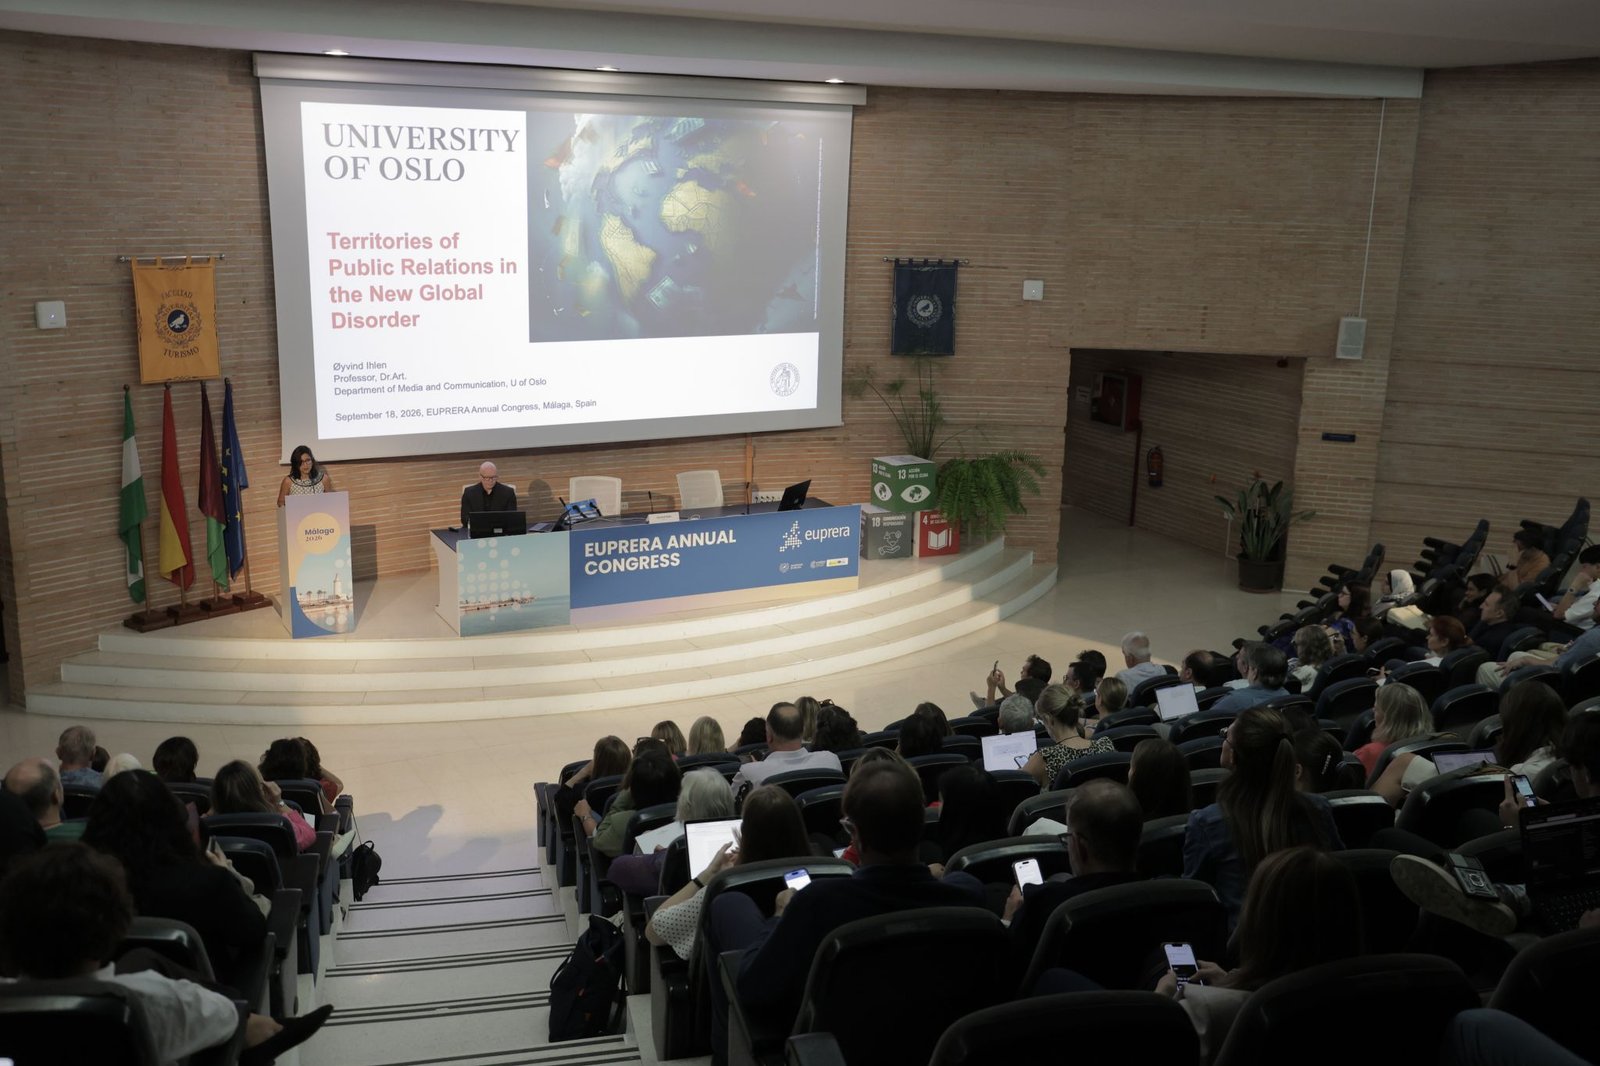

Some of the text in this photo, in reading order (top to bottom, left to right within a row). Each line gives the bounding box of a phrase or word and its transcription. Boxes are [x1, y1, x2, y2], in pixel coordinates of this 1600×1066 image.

[322, 123, 520, 152] UNIVERSITY
[324, 155, 465, 182] OF OSLO
[326, 232, 460, 250] Territories of
[329, 258, 517, 276] Public Relations in
[329, 284, 483, 303] the New Global
[331, 311, 420, 329] Disorder
[163, 345, 200, 359] TURISMO
[333, 361, 387, 372] Øyvind Ihlen
[333, 373, 377, 383] Professor,
[334, 378, 547, 396] Department of Media and Communication, U of Oslo
[335, 399, 597, 422] September 18, 2026, EUPRERA Annual Congress, Málaga, Spain
[897, 469, 907, 480] 13
[872, 516, 881, 527] 18
[922, 515, 928, 525] 4
[304, 528, 335, 536] Málaga
[804, 526, 850, 543] euprera
[584, 529, 736, 558] EUPRERA ANNUAL
[584, 552, 681, 575] CONGRESS
